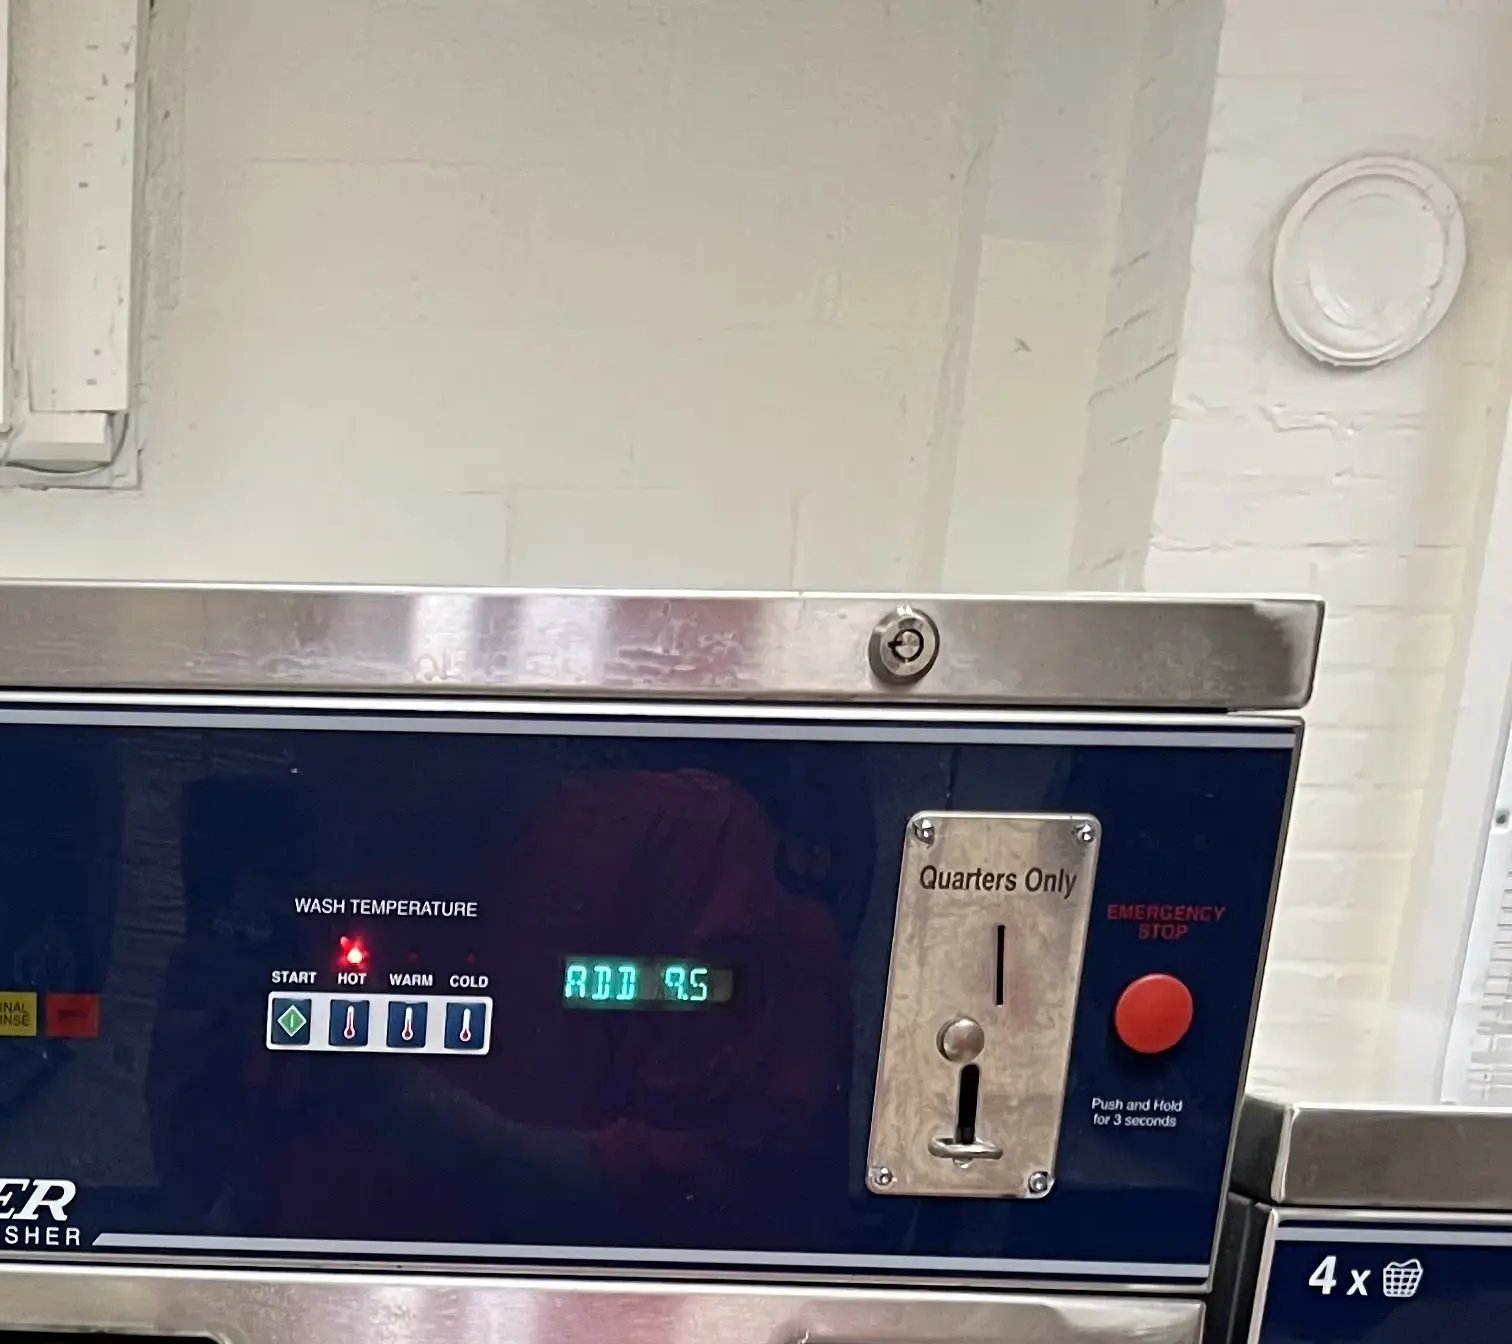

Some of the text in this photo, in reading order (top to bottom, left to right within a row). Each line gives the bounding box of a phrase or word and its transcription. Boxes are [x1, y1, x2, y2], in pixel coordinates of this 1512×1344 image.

[920, 865, 1077, 899] Quarters Only
[295, 898, 478, 917] WASH TEMPERATURE
[1107, 904, 1226, 922] EMERGENCY
[1138, 923, 1188, 940] STOP
[272, 970, 488, 988] START HOT WARM COLD
[565, 965, 636, 1000] ADD
[1092, 1098, 1183, 1112] Push and Hold
[1094, 1114, 1176, 1128] for 3 seconds
[1308, 1255, 1371, 1296] 4 x
